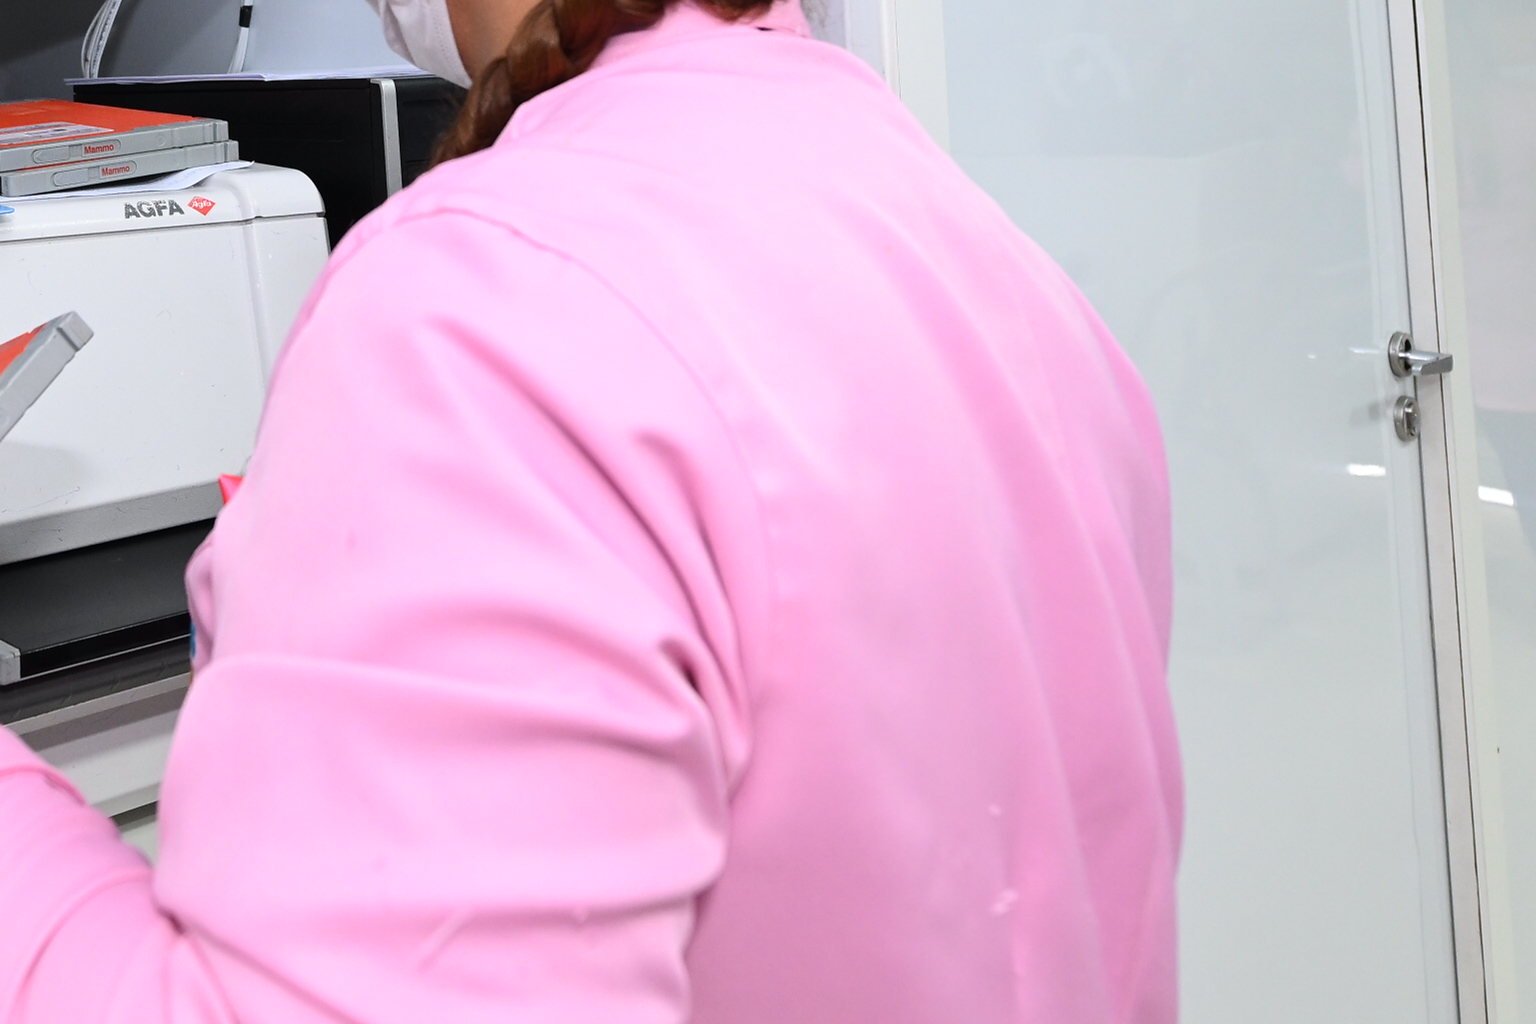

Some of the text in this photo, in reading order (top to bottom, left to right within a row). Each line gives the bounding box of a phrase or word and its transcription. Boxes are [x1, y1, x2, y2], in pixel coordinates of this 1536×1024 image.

[84, 143, 114, 155] Mammo
[102, 165, 131, 177] Mammo
[125, 200, 185, 219] AGFA
